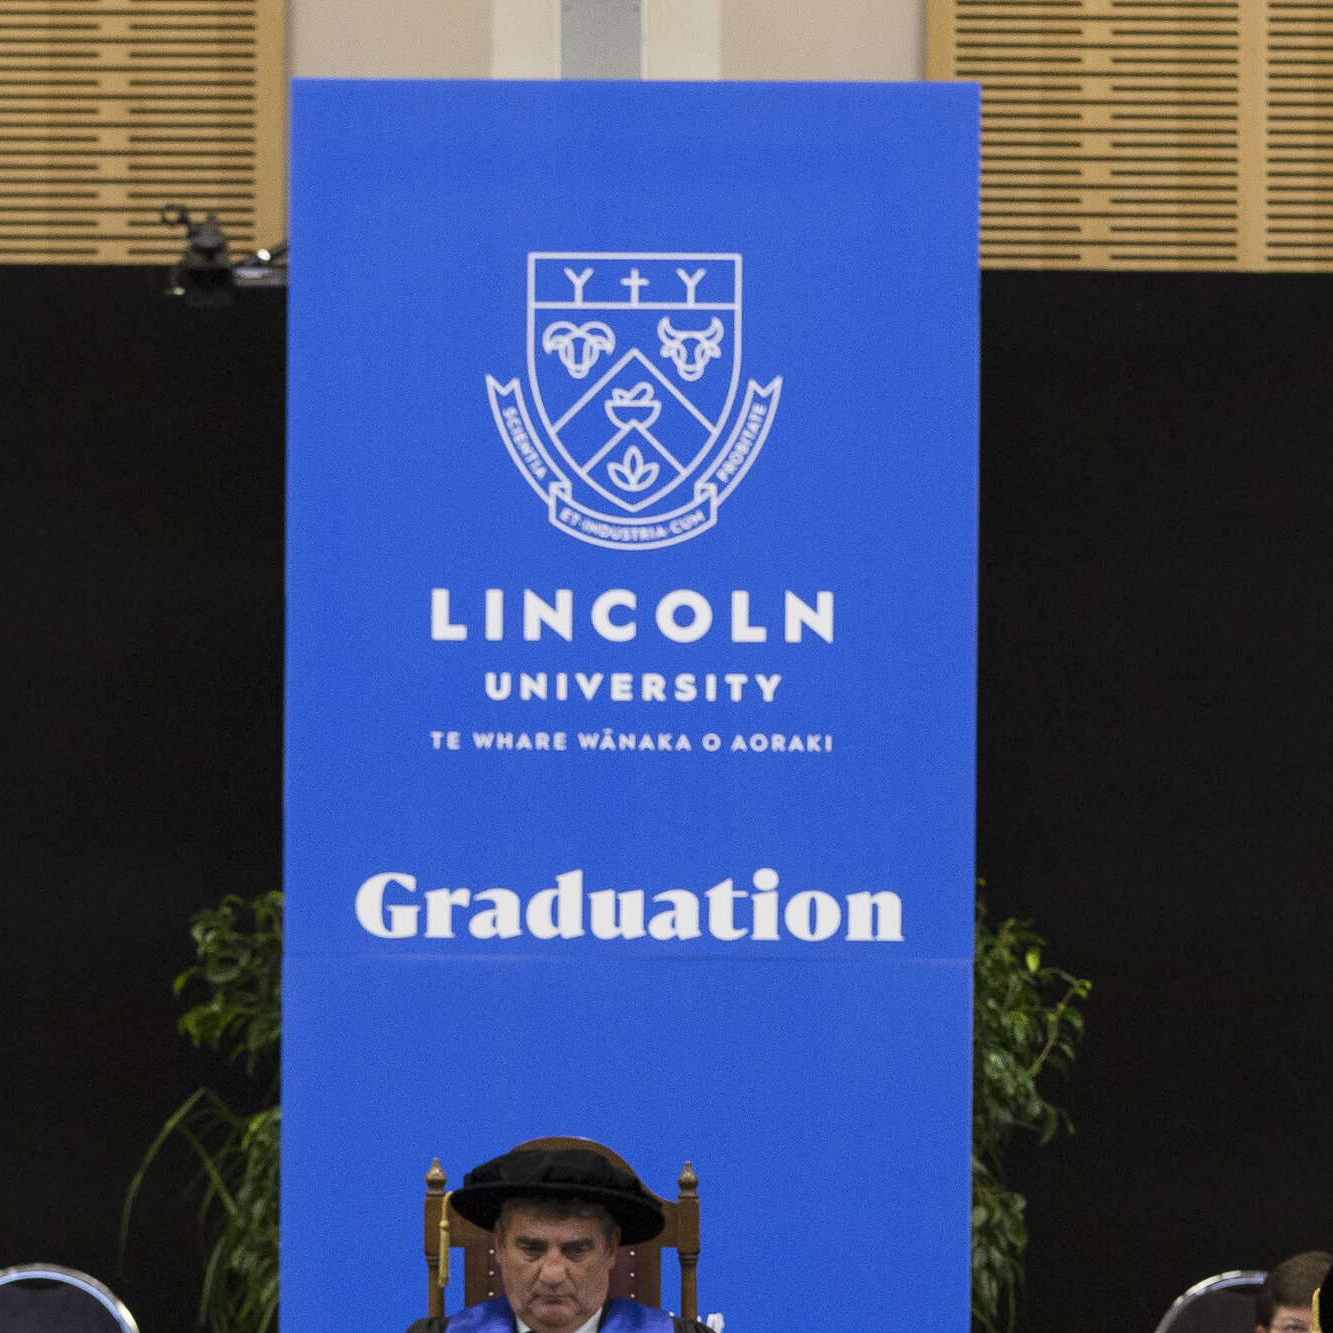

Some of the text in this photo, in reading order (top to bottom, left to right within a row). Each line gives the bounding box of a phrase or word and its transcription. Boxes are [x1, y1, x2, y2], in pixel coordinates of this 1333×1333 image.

[502, 406, 547, 480] SCIENTIA
[716, 402, 767, 483] PROBITATE
[431, 588, 834, 644] LINCOLN
[485, 672, 782, 703] UNIVERSITY
[431, 728, 832, 752] TE WHARE WĀNAKA O AORAKI
[355, 867, 904, 942] Graduation
